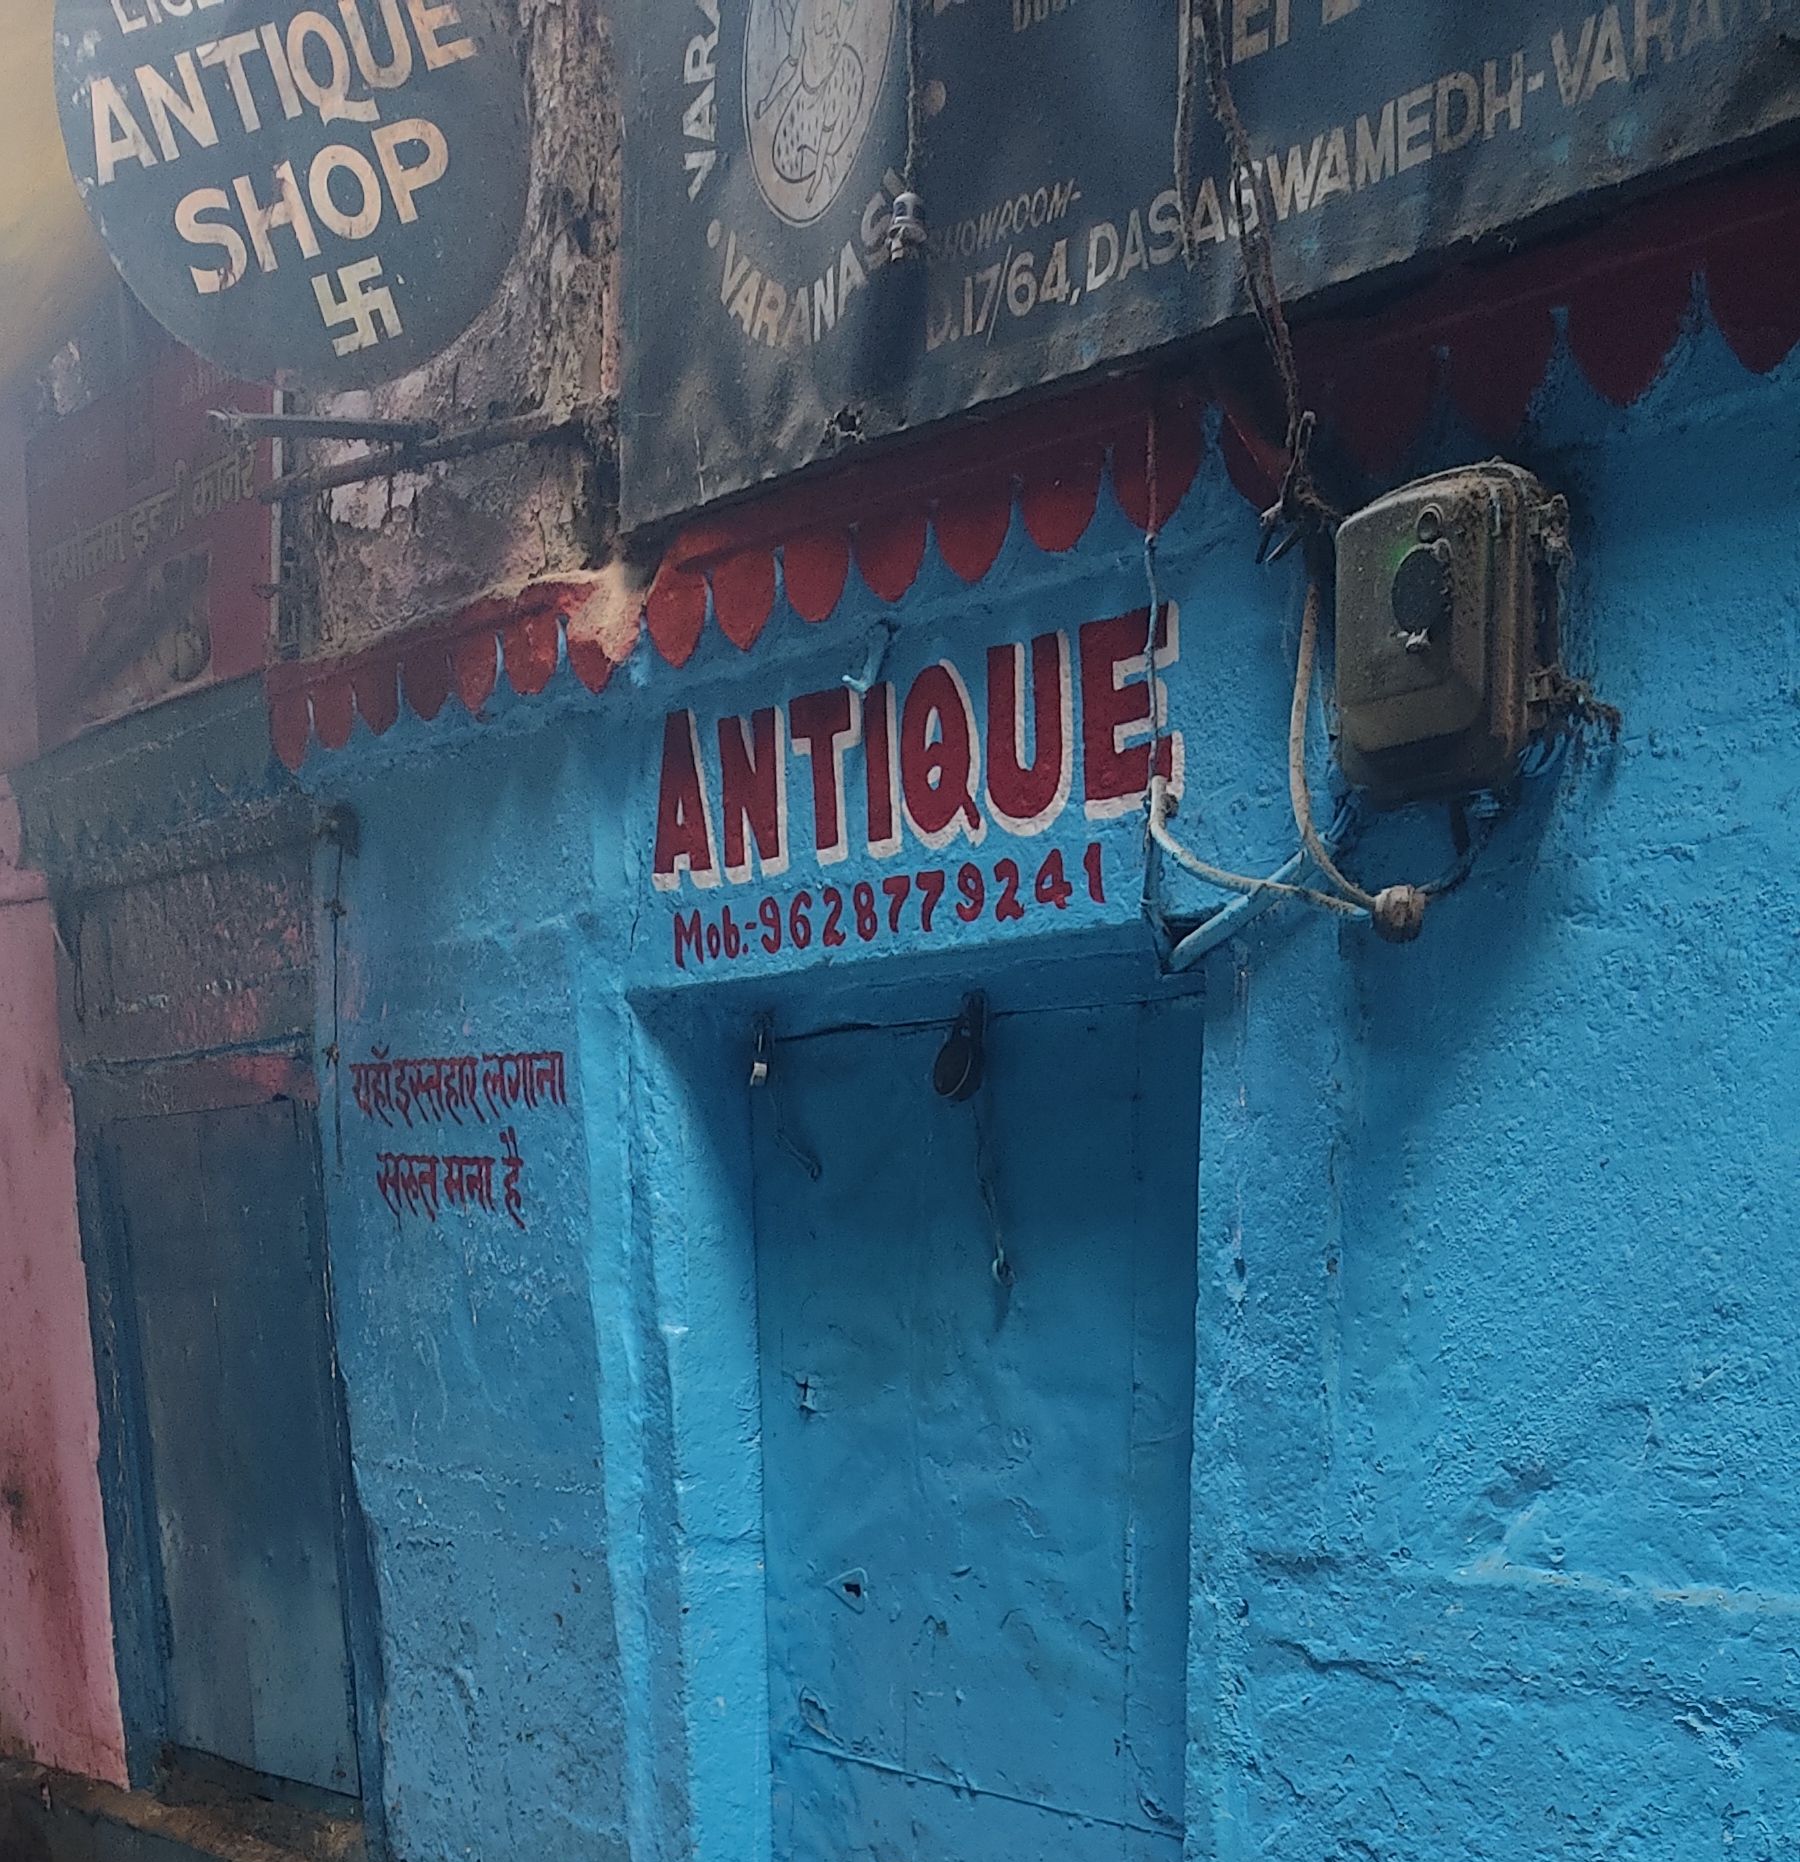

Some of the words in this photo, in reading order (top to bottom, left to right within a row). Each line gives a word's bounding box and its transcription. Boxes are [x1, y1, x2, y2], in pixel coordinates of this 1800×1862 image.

[90, 0, 479, 186] ANTIQUE
[173, 117, 449, 294] SHOP
[652, 600, 1184, 891] ANTIQUE
[482, 1050, 567, 1119] लगाना
[442, 1154, 497, 1213] मना
[499, 1126, 525, 1230] है
